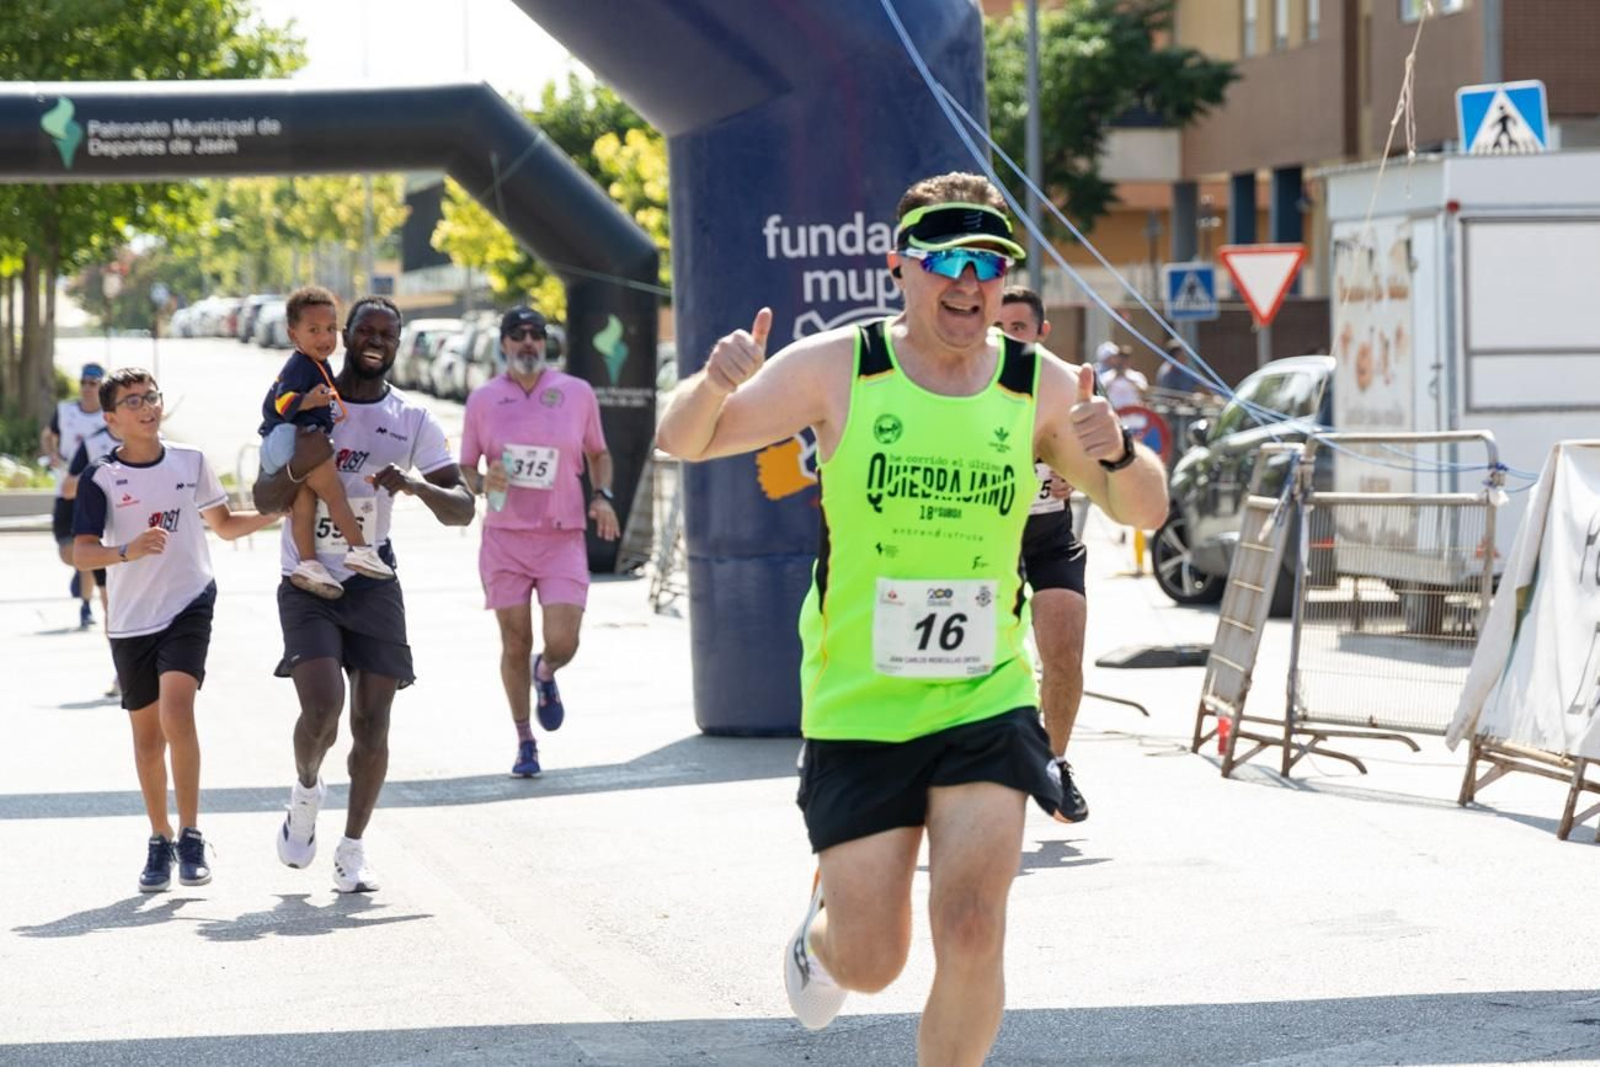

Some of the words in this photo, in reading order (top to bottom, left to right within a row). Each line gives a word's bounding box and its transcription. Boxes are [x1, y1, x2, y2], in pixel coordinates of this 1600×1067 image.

[87, 118, 171, 140] Patronato
[172, 116, 255, 140] Municipal
[257, 117, 282, 136] de
[87, 137, 166, 159] Deportes
[168, 136, 193, 155] de
[513, 459, 548, 478] 315
[905, 454, 948, 466] corrido
[914, 612, 968, 652] 16
